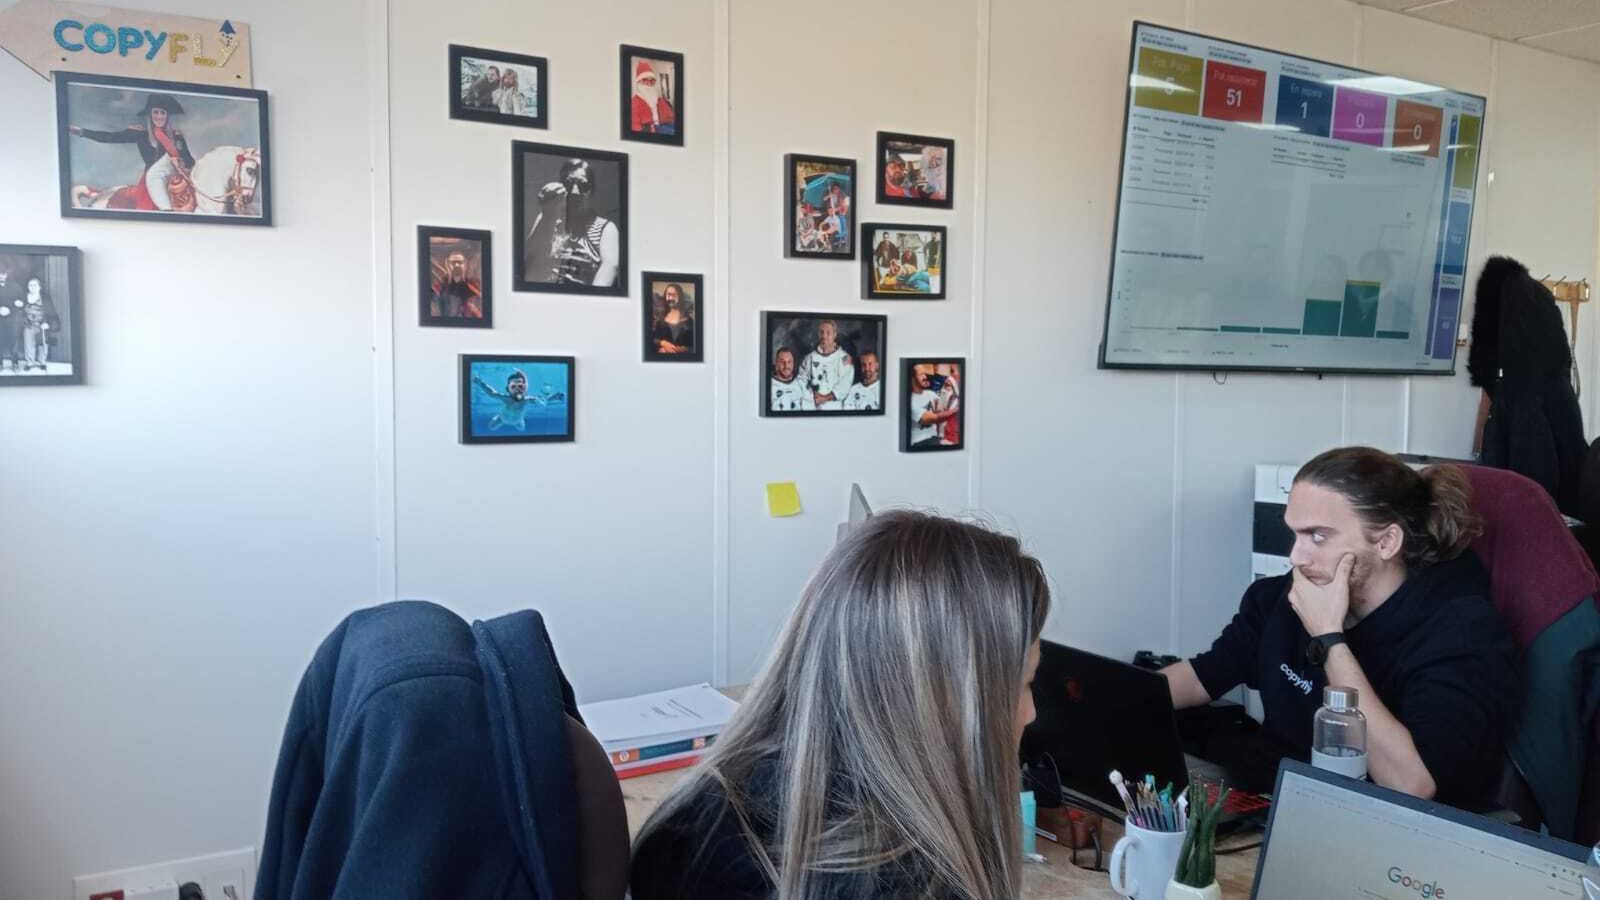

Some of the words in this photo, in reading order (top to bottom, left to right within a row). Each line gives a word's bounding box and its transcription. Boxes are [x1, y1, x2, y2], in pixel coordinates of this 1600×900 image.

[1226, 88, 1243, 107] 51
[1300, 101, 1308, 119] 1
[1355, 112, 1365, 128] 0
[1413, 124, 1423, 140] 0
[1280, 664, 1313, 695] copyfly
[1388, 866, 1445, 899] Google
